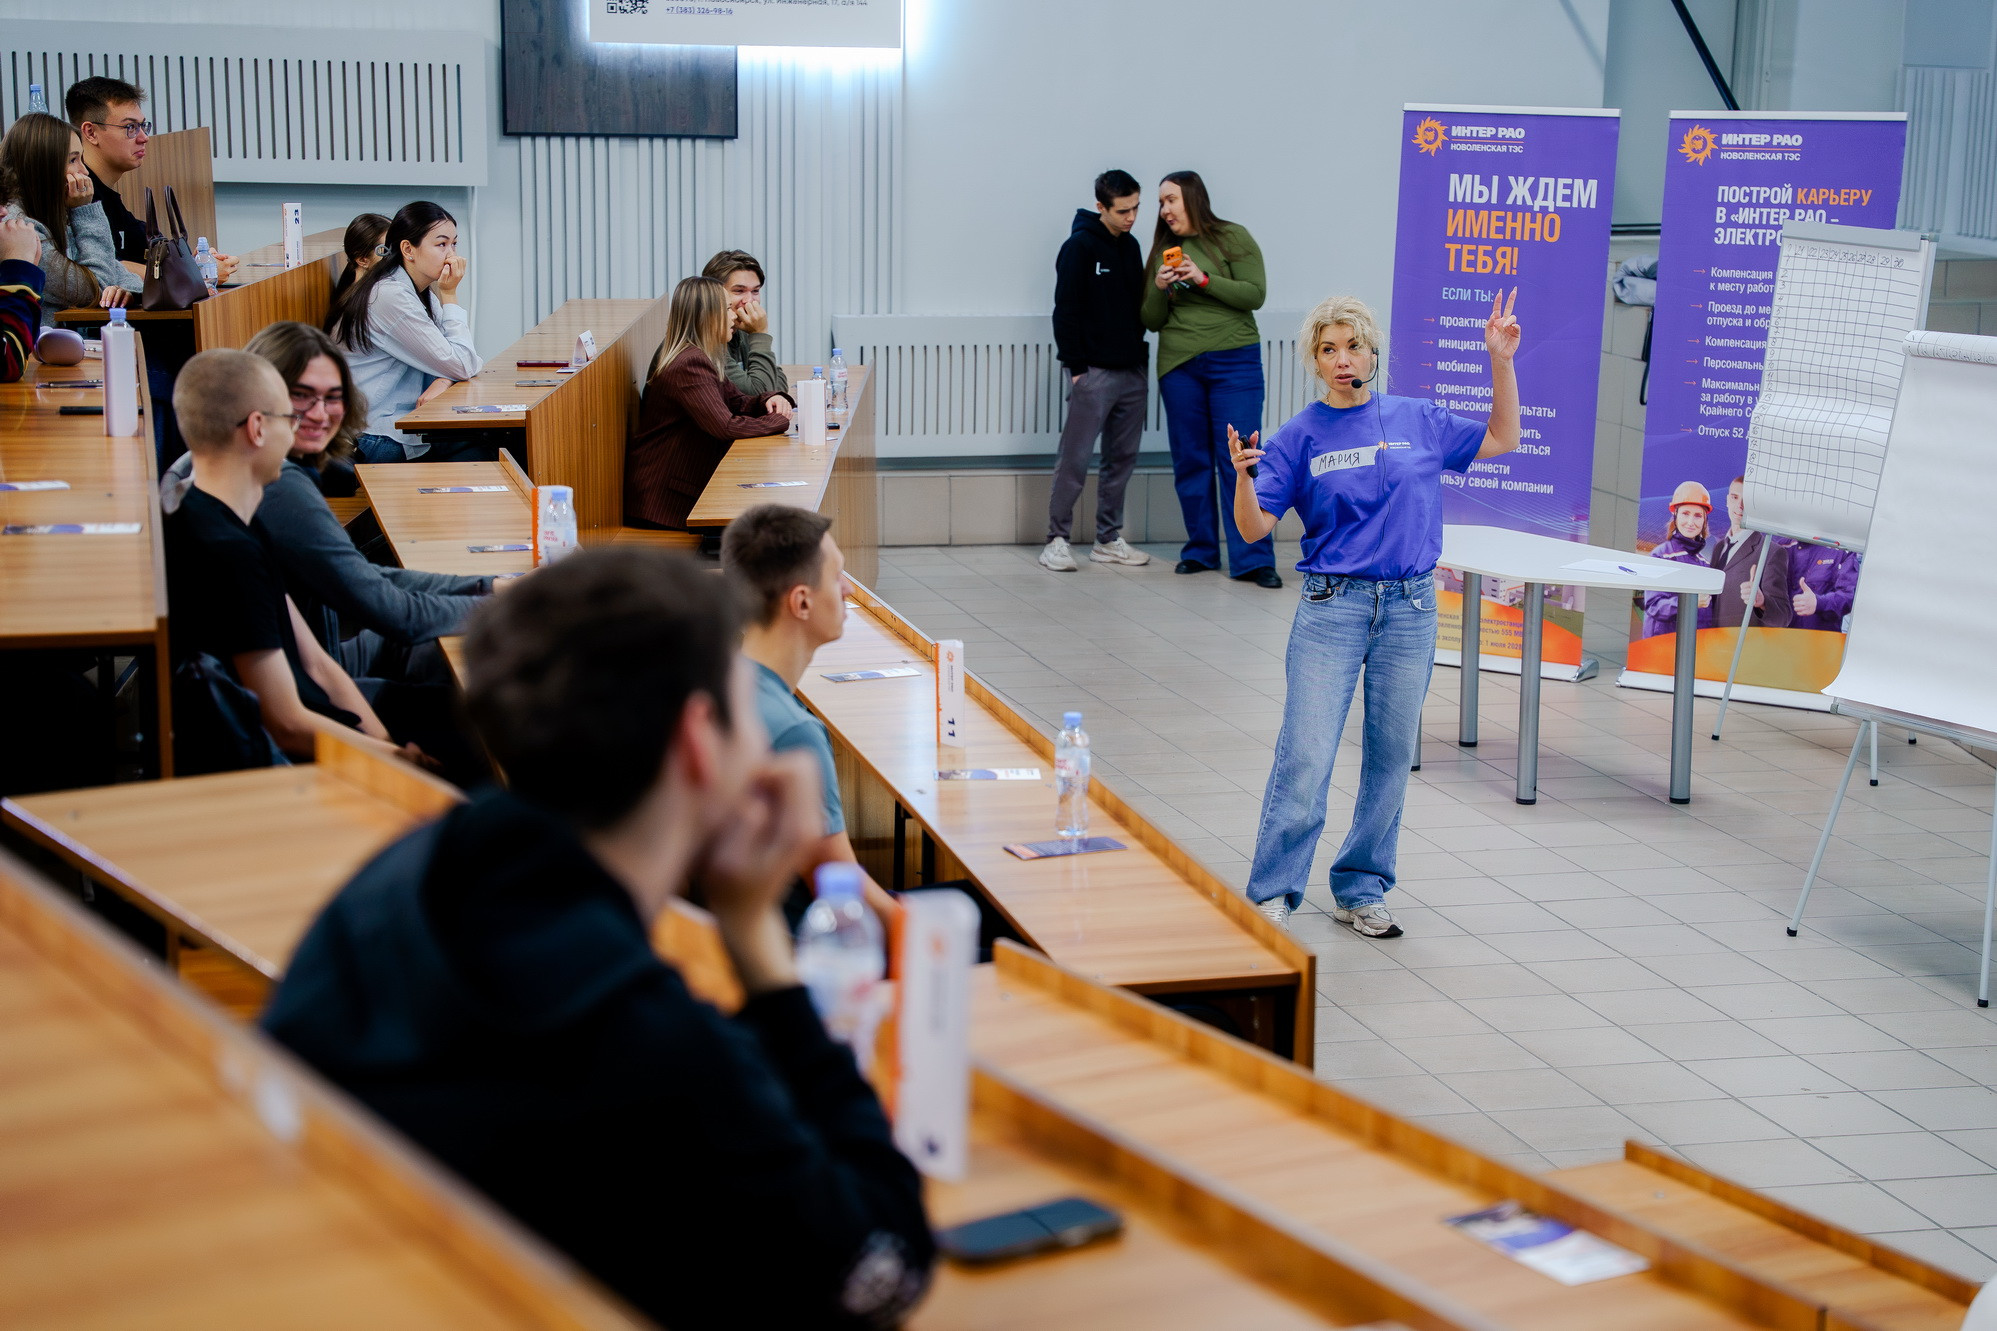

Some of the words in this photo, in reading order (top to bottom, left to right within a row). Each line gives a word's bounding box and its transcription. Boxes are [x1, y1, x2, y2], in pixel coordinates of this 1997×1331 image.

[1451, 126, 1496, 138] ИНТЕР
[1497, 127, 1525, 139] РАО
[1721, 133, 1771, 146] ИНТЕР
[1772, 134, 1803, 147] РАО
[1450, 143, 1507, 153] НОВОЛЕНСКАЯ
[1508, 145, 1524, 153] ТЭС
[1720, 152, 1782, 161] НОВОЛЕНСКАЯ
[1784, 153, 1801, 161] ТЭС
[1449, 173, 1498, 204] МЫ
[1506, 175, 1597, 212] ЖДЕМ
[1717, 183, 1793, 205] ПОСТРОЙ
[1796, 187, 1873, 207] КАРЬЕРУ
[1715, 207, 1727, 224] В
[1446, 208, 1561, 243] ИМЕННО
[1444, 243, 1519, 275] ТЕБЯ!
[1711, 267, 1773, 280] Компенсация
[1442, 287, 1471, 301] ЕСЛИ
[1474, 289, 1494, 303] ТЫ:
[1710, 282, 1715, 291] к
[1717, 283, 1745, 294] месту
[1746, 282, 1775, 294] работ
[1708, 301, 1742, 315] Проезд
[1744, 305, 1756, 315] до
[1439, 315, 1487, 329] проактив
[1707, 316, 1743, 328] отпуска
[1745, 319, 1752, 327] и
[1753, 318, 1770, 330] обр
[1438, 338, 1488, 352] инициати
[1705, 335, 1767, 350] Компенсация
[1436, 360, 1483, 374] мобилен
[1703, 356, 1764, 370] Персональны
[1435, 383, 1494, 399] ориентиро
[1702, 378, 1760, 391] Максимальн
[1700, 392, 1711, 402] за
[1713, 392, 1746, 406] работу
[1747, 396, 1753, 404] в
[1520, 406, 1556, 418] льтаты
[1700, 403, 1743, 416] Крайнего
[1698, 424, 1731, 438] Отпуск
[1732, 427, 1744, 438] 52
[1318, 451, 1360, 472] МАРИЯ
[1468, 461, 1510, 475] ринести
[1441, 474, 1466, 488] льзу
[1468, 477, 1499, 490] своей
[1501, 481, 1554, 495] компании
